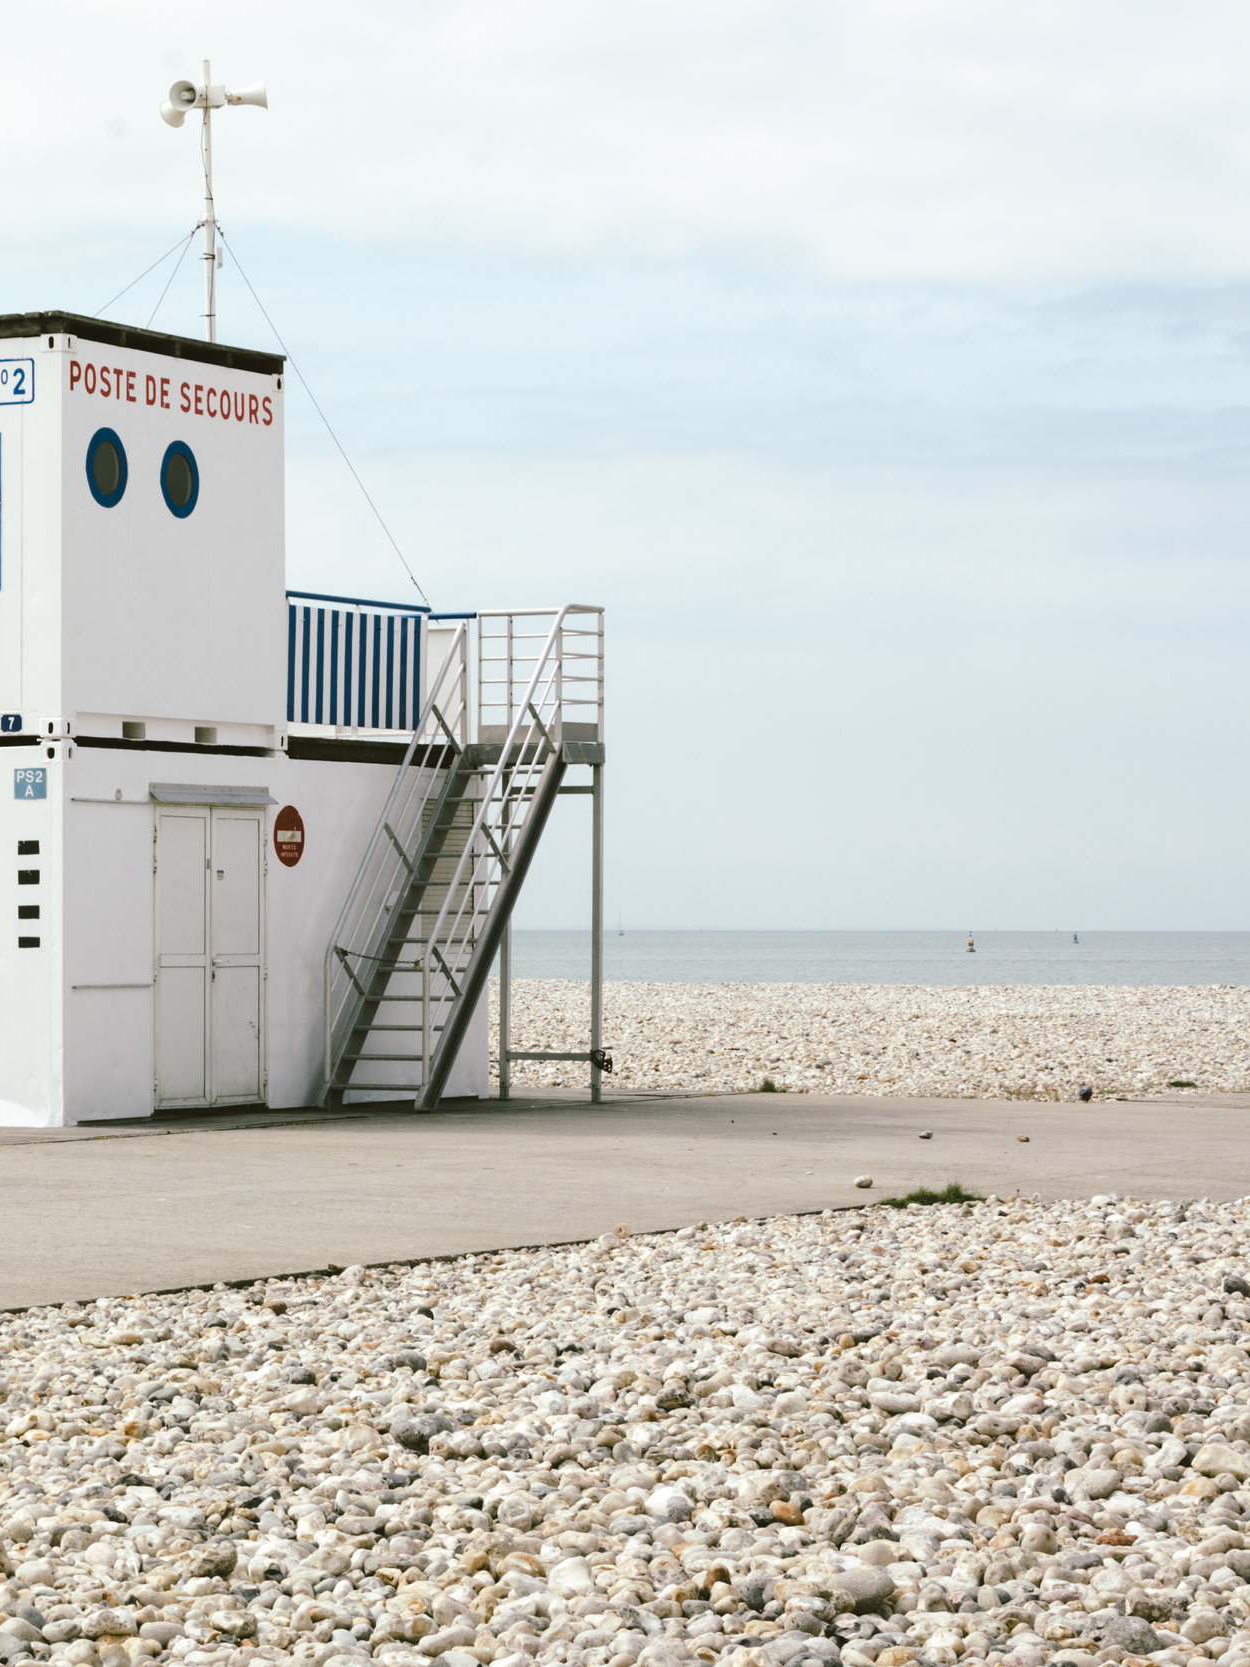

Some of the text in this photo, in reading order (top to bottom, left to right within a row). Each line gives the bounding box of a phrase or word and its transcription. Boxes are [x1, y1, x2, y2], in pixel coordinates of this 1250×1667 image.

[70, 360, 273, 426] POSTE DE SECOURS
[7, 717, 15, 730] 7
[16, 770, 43, 783] PS2
[24, 784, 34, 797] A
